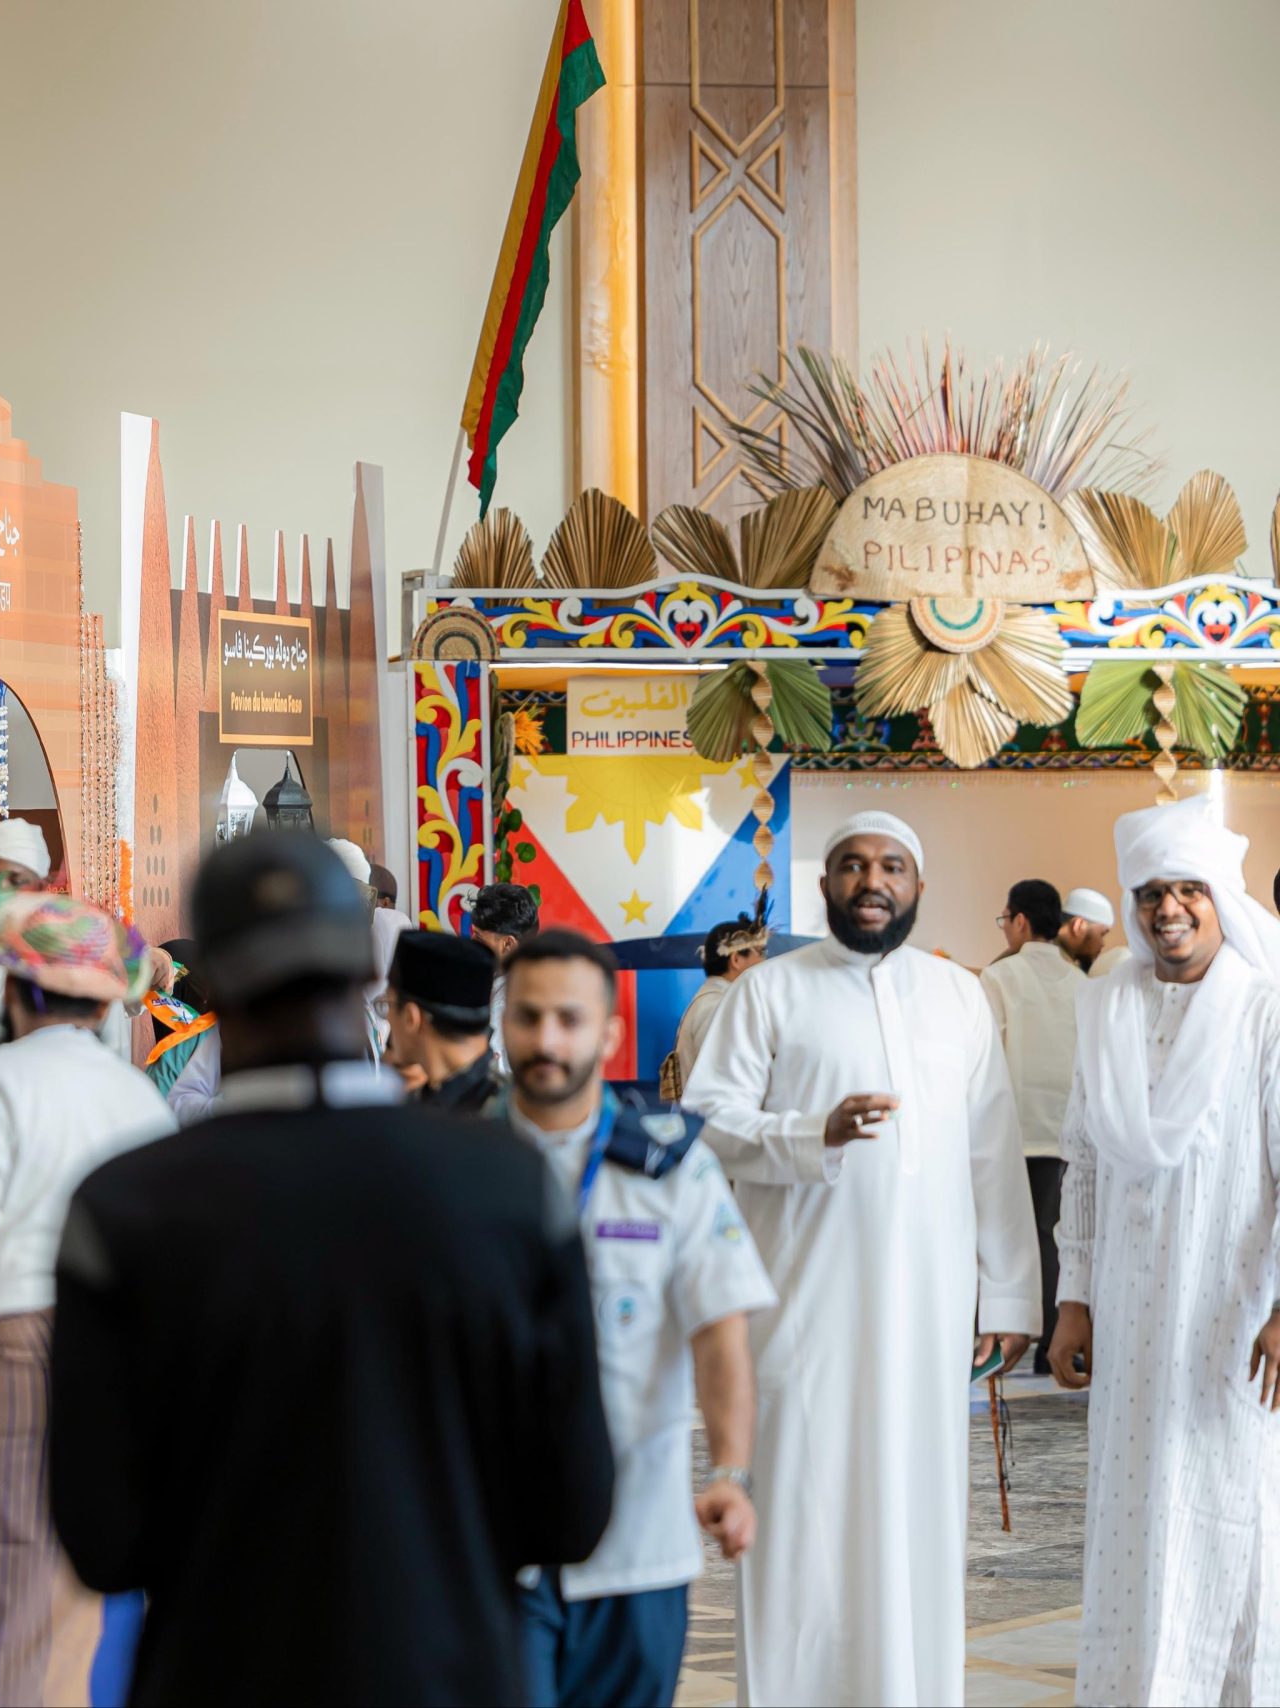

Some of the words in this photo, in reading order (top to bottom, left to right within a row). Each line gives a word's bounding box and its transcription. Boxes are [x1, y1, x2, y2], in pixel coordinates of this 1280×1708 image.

[863, 540, 1051, 578] PILIPINAS
[223, 630, 242, 666] فاسو
[243, 632, 274, 669] بوركينا
[275, 633, 291, 670] دولة
[290, 637, 308, 671] جناح
[288, 694, 303, 714] Faso
[580, 681, 688, 719] الفلبين
[571, 730, 695, 749] PHILIPPINES
